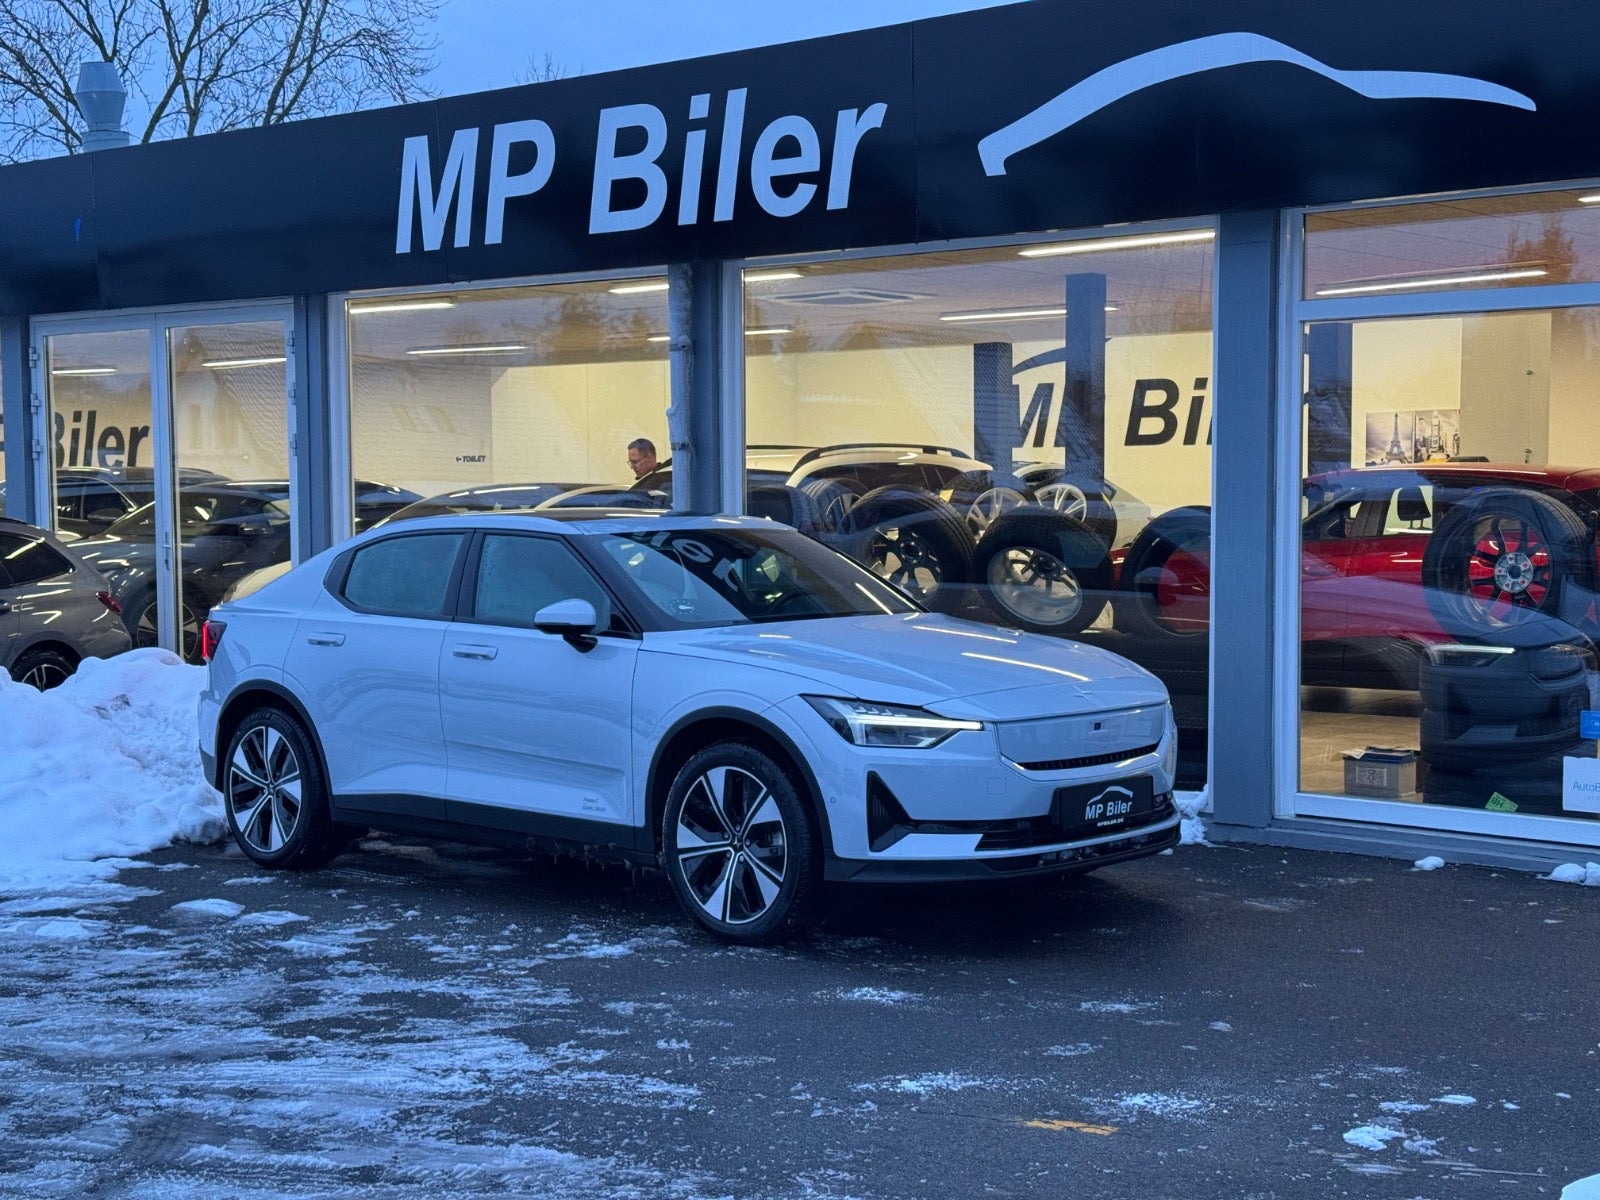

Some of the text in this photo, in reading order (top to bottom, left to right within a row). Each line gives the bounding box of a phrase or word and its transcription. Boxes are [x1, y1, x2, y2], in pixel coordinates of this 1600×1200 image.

[395, 87, 888, 254] MP Biler
[1124, 377, 1213, 446] Bi
[462, 455, 487, 463] TOILET
[1085, 800, 1133, 821] MP Biler
